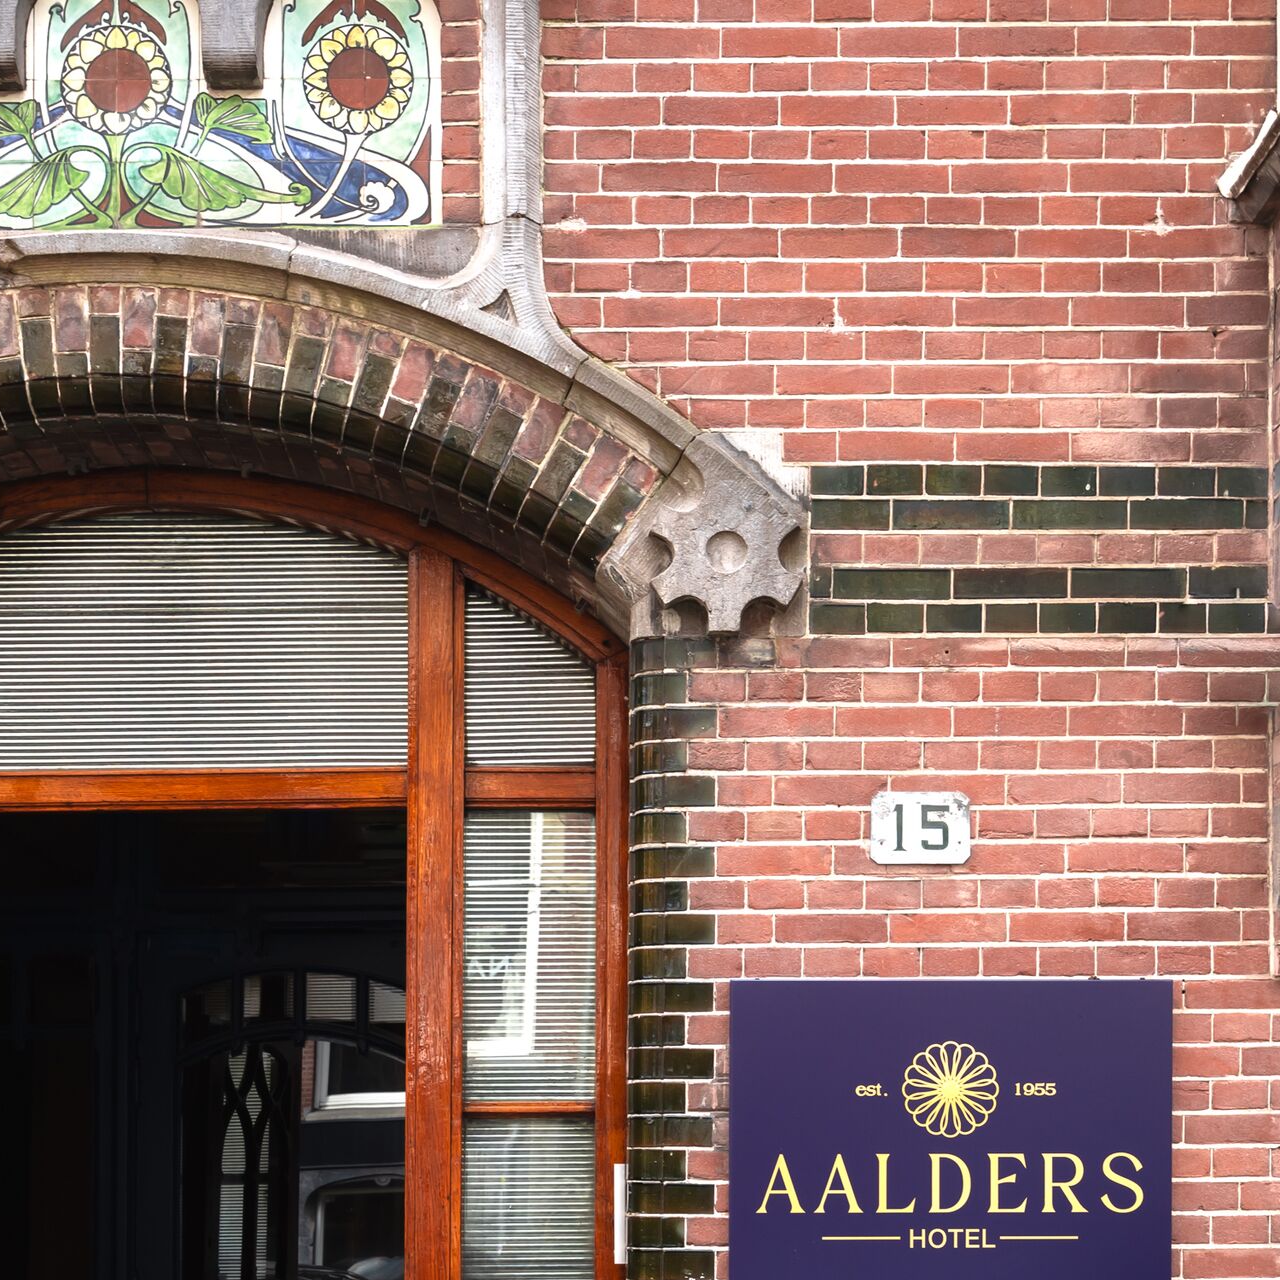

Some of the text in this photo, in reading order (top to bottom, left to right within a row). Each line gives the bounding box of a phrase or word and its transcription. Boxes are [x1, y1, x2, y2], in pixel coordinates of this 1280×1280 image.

[893, 804, 950, 852] 15
[855, 1082, 1057, 1097] est. 1955
[756, 1151, 1144, 1214] AALDERS
[909, 1228, 996, 1249] HOTEL
